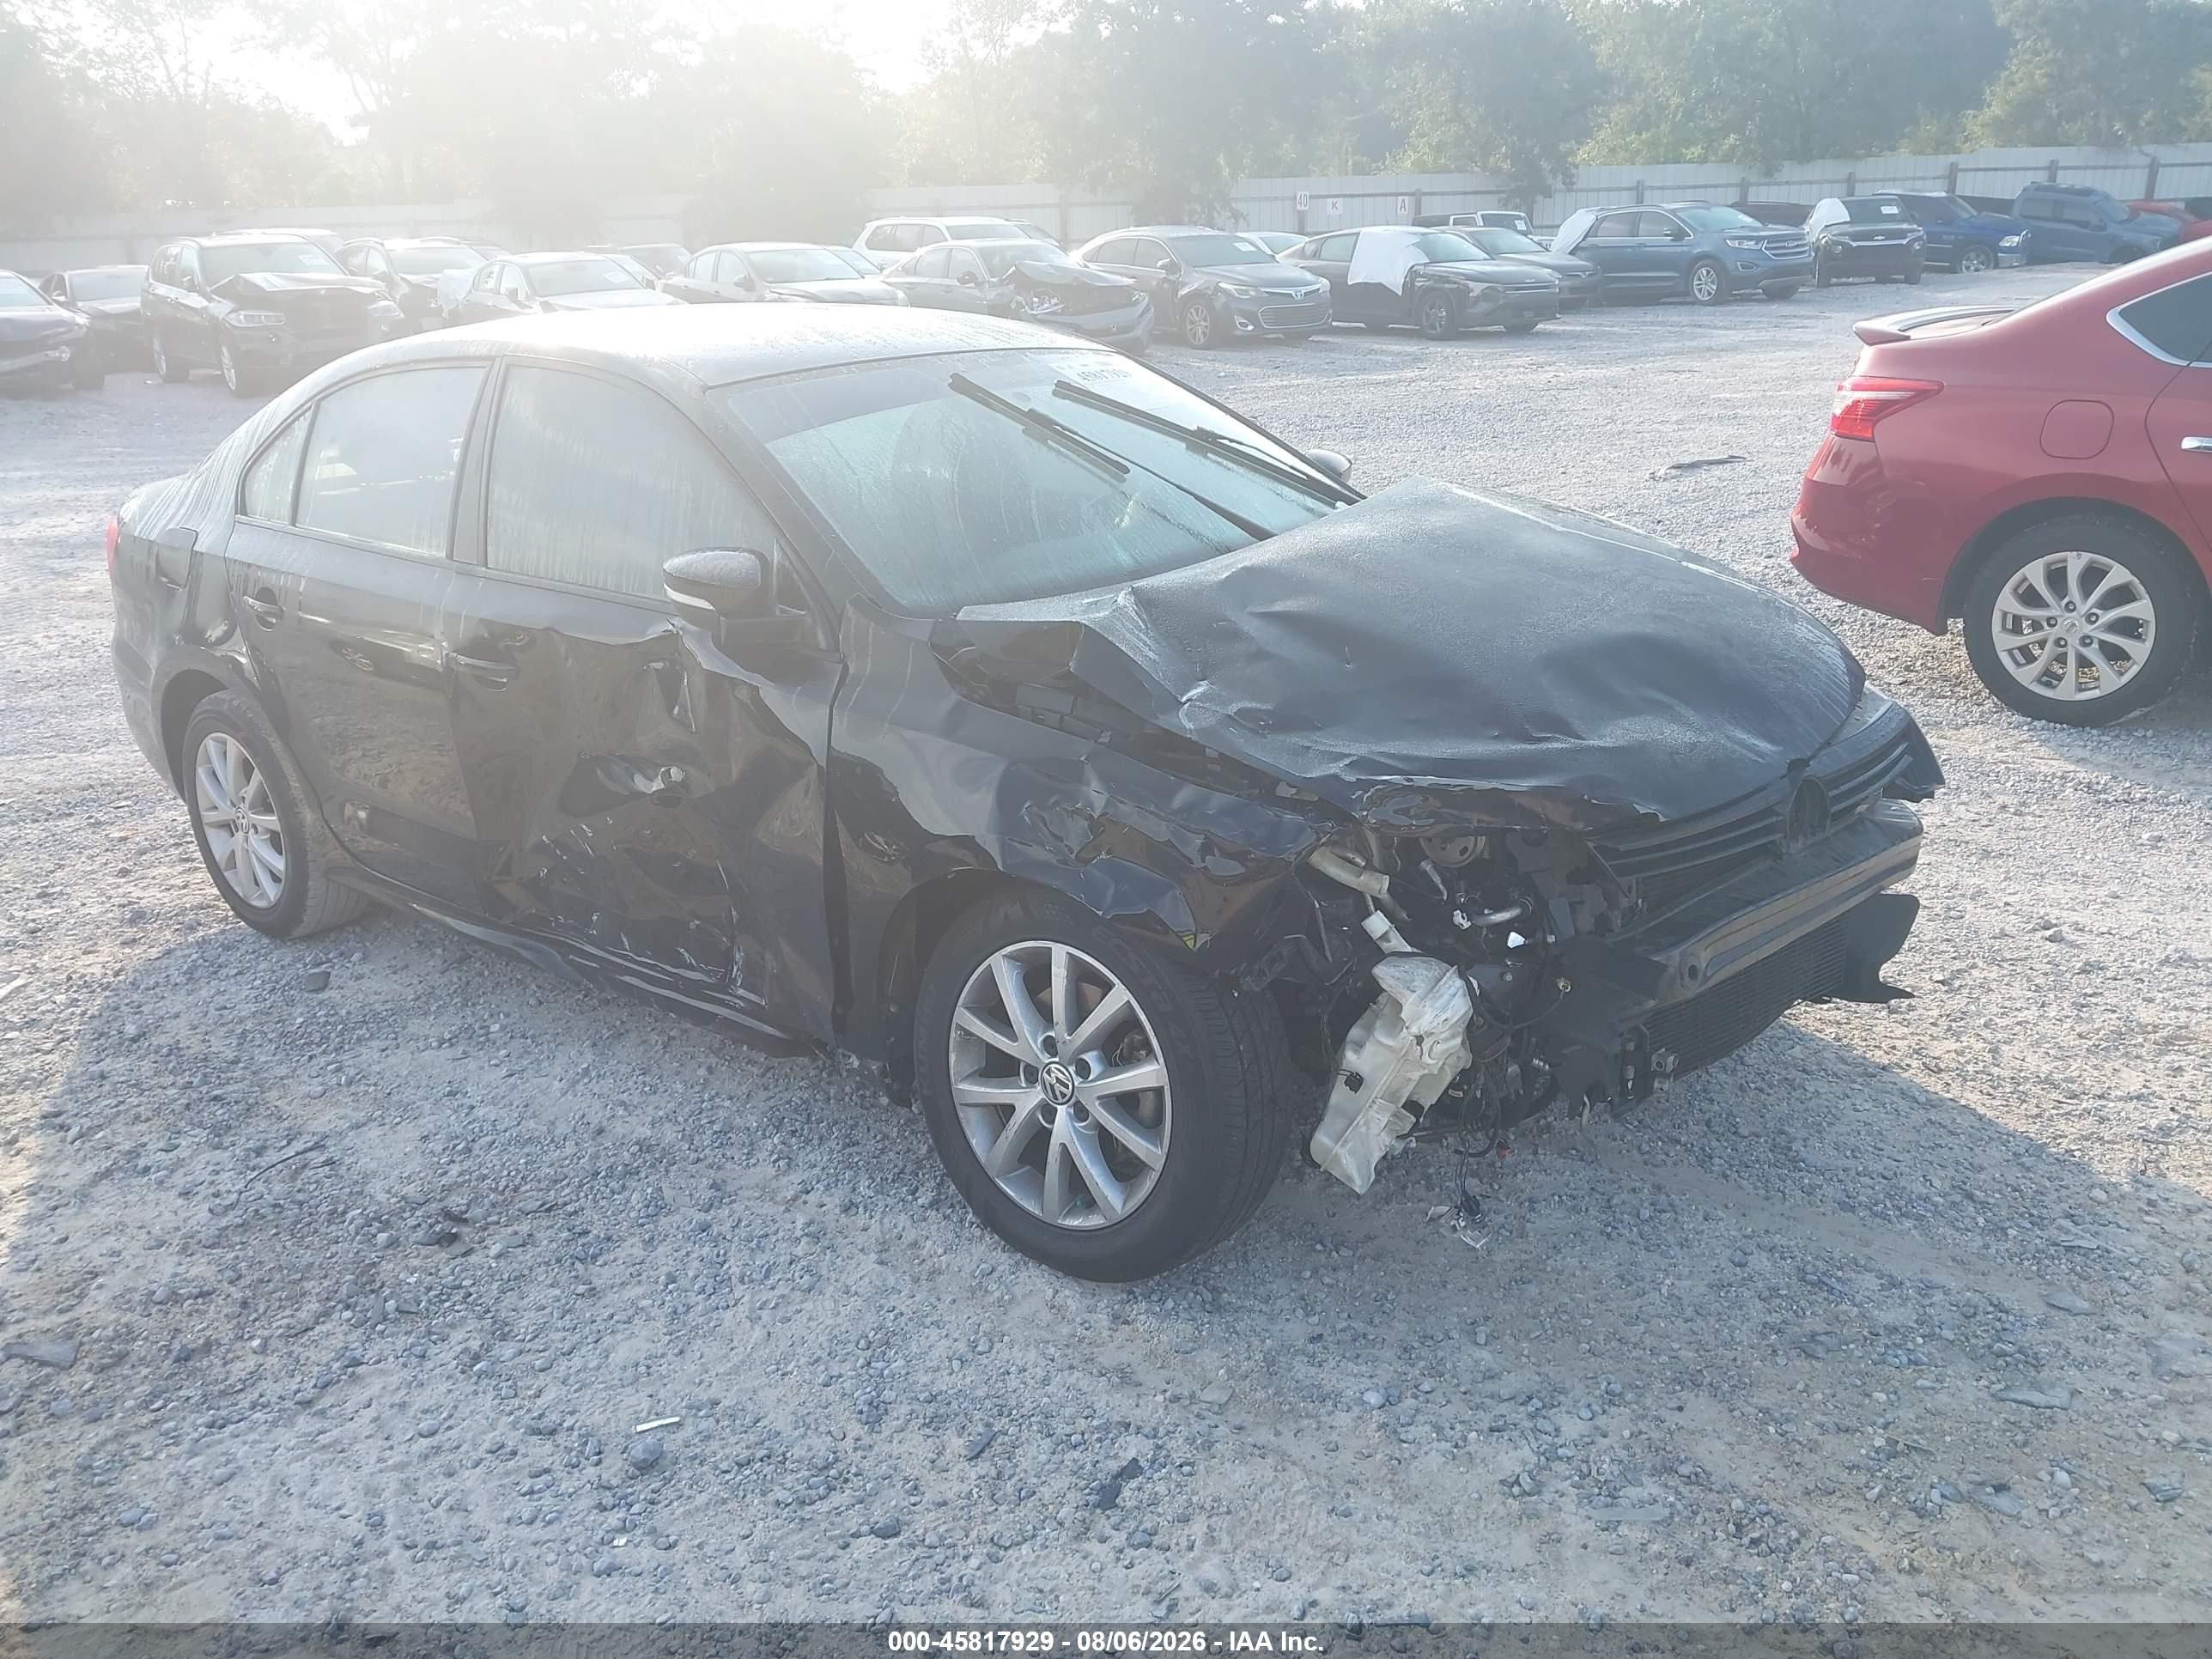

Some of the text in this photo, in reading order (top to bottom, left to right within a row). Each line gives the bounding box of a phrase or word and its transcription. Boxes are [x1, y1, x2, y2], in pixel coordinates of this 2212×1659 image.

[1297, 193, 1308, 207] 40
[1332, 200, 1339, 210] K
[1399, 198, 1407, 211] A
